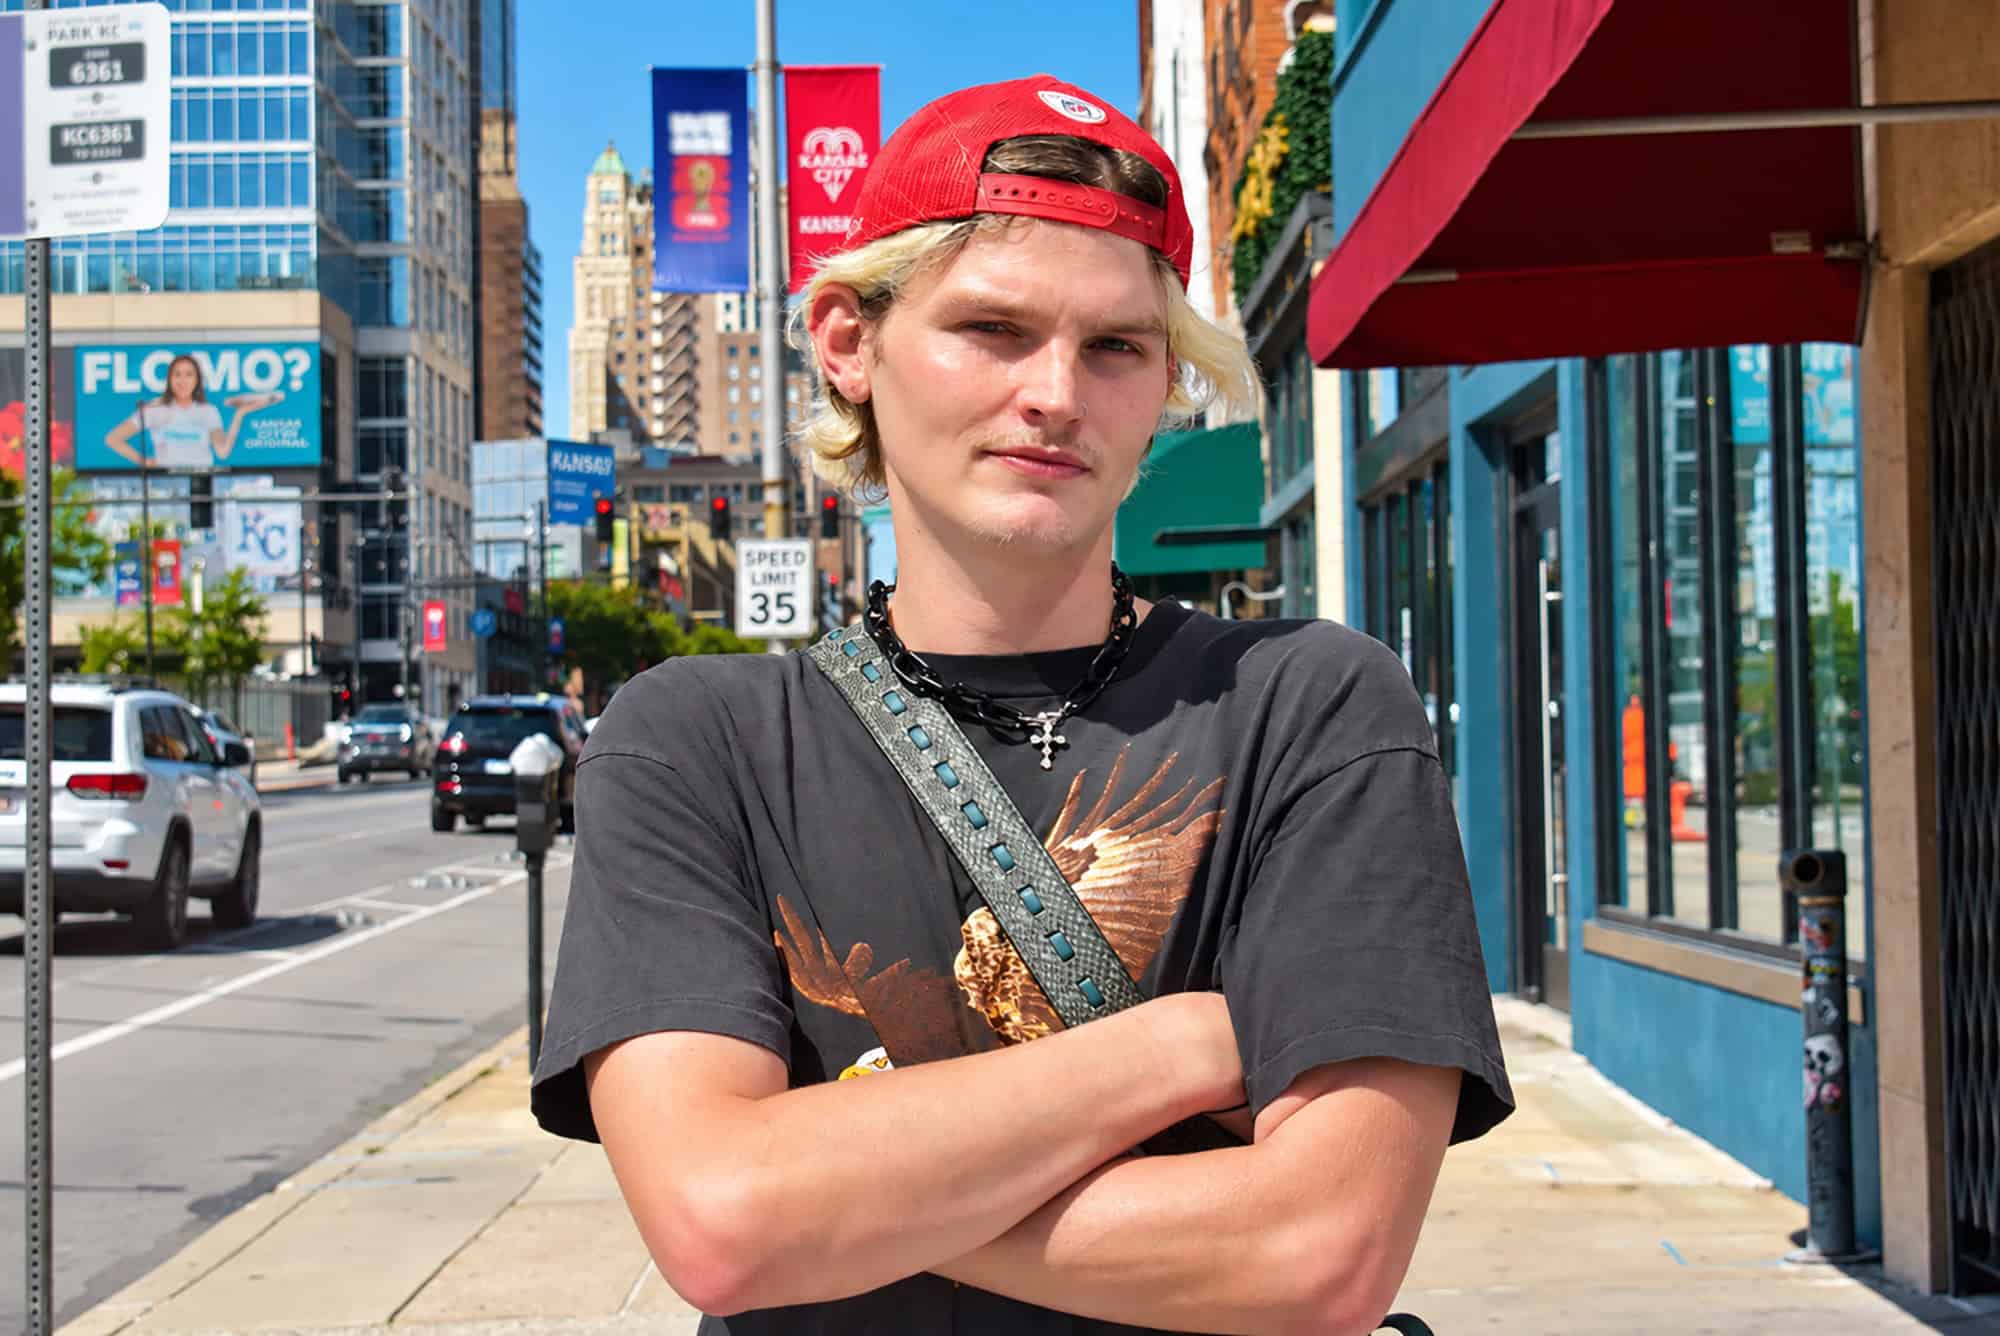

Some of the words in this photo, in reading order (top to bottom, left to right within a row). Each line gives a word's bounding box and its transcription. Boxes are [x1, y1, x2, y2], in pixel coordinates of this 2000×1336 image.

[48, 27, 94, 41] PARK
[99, 24, 121, 38] KC
[70, 60, 125, 84] 6361
[60, 123, 134, 146] KC6361
[238, 510, 288, 561] KC
[744, 549, 807, 568] SPEED
[751, 570, 797, 586] LIMIT
[749, 592, 796, 625] 35
